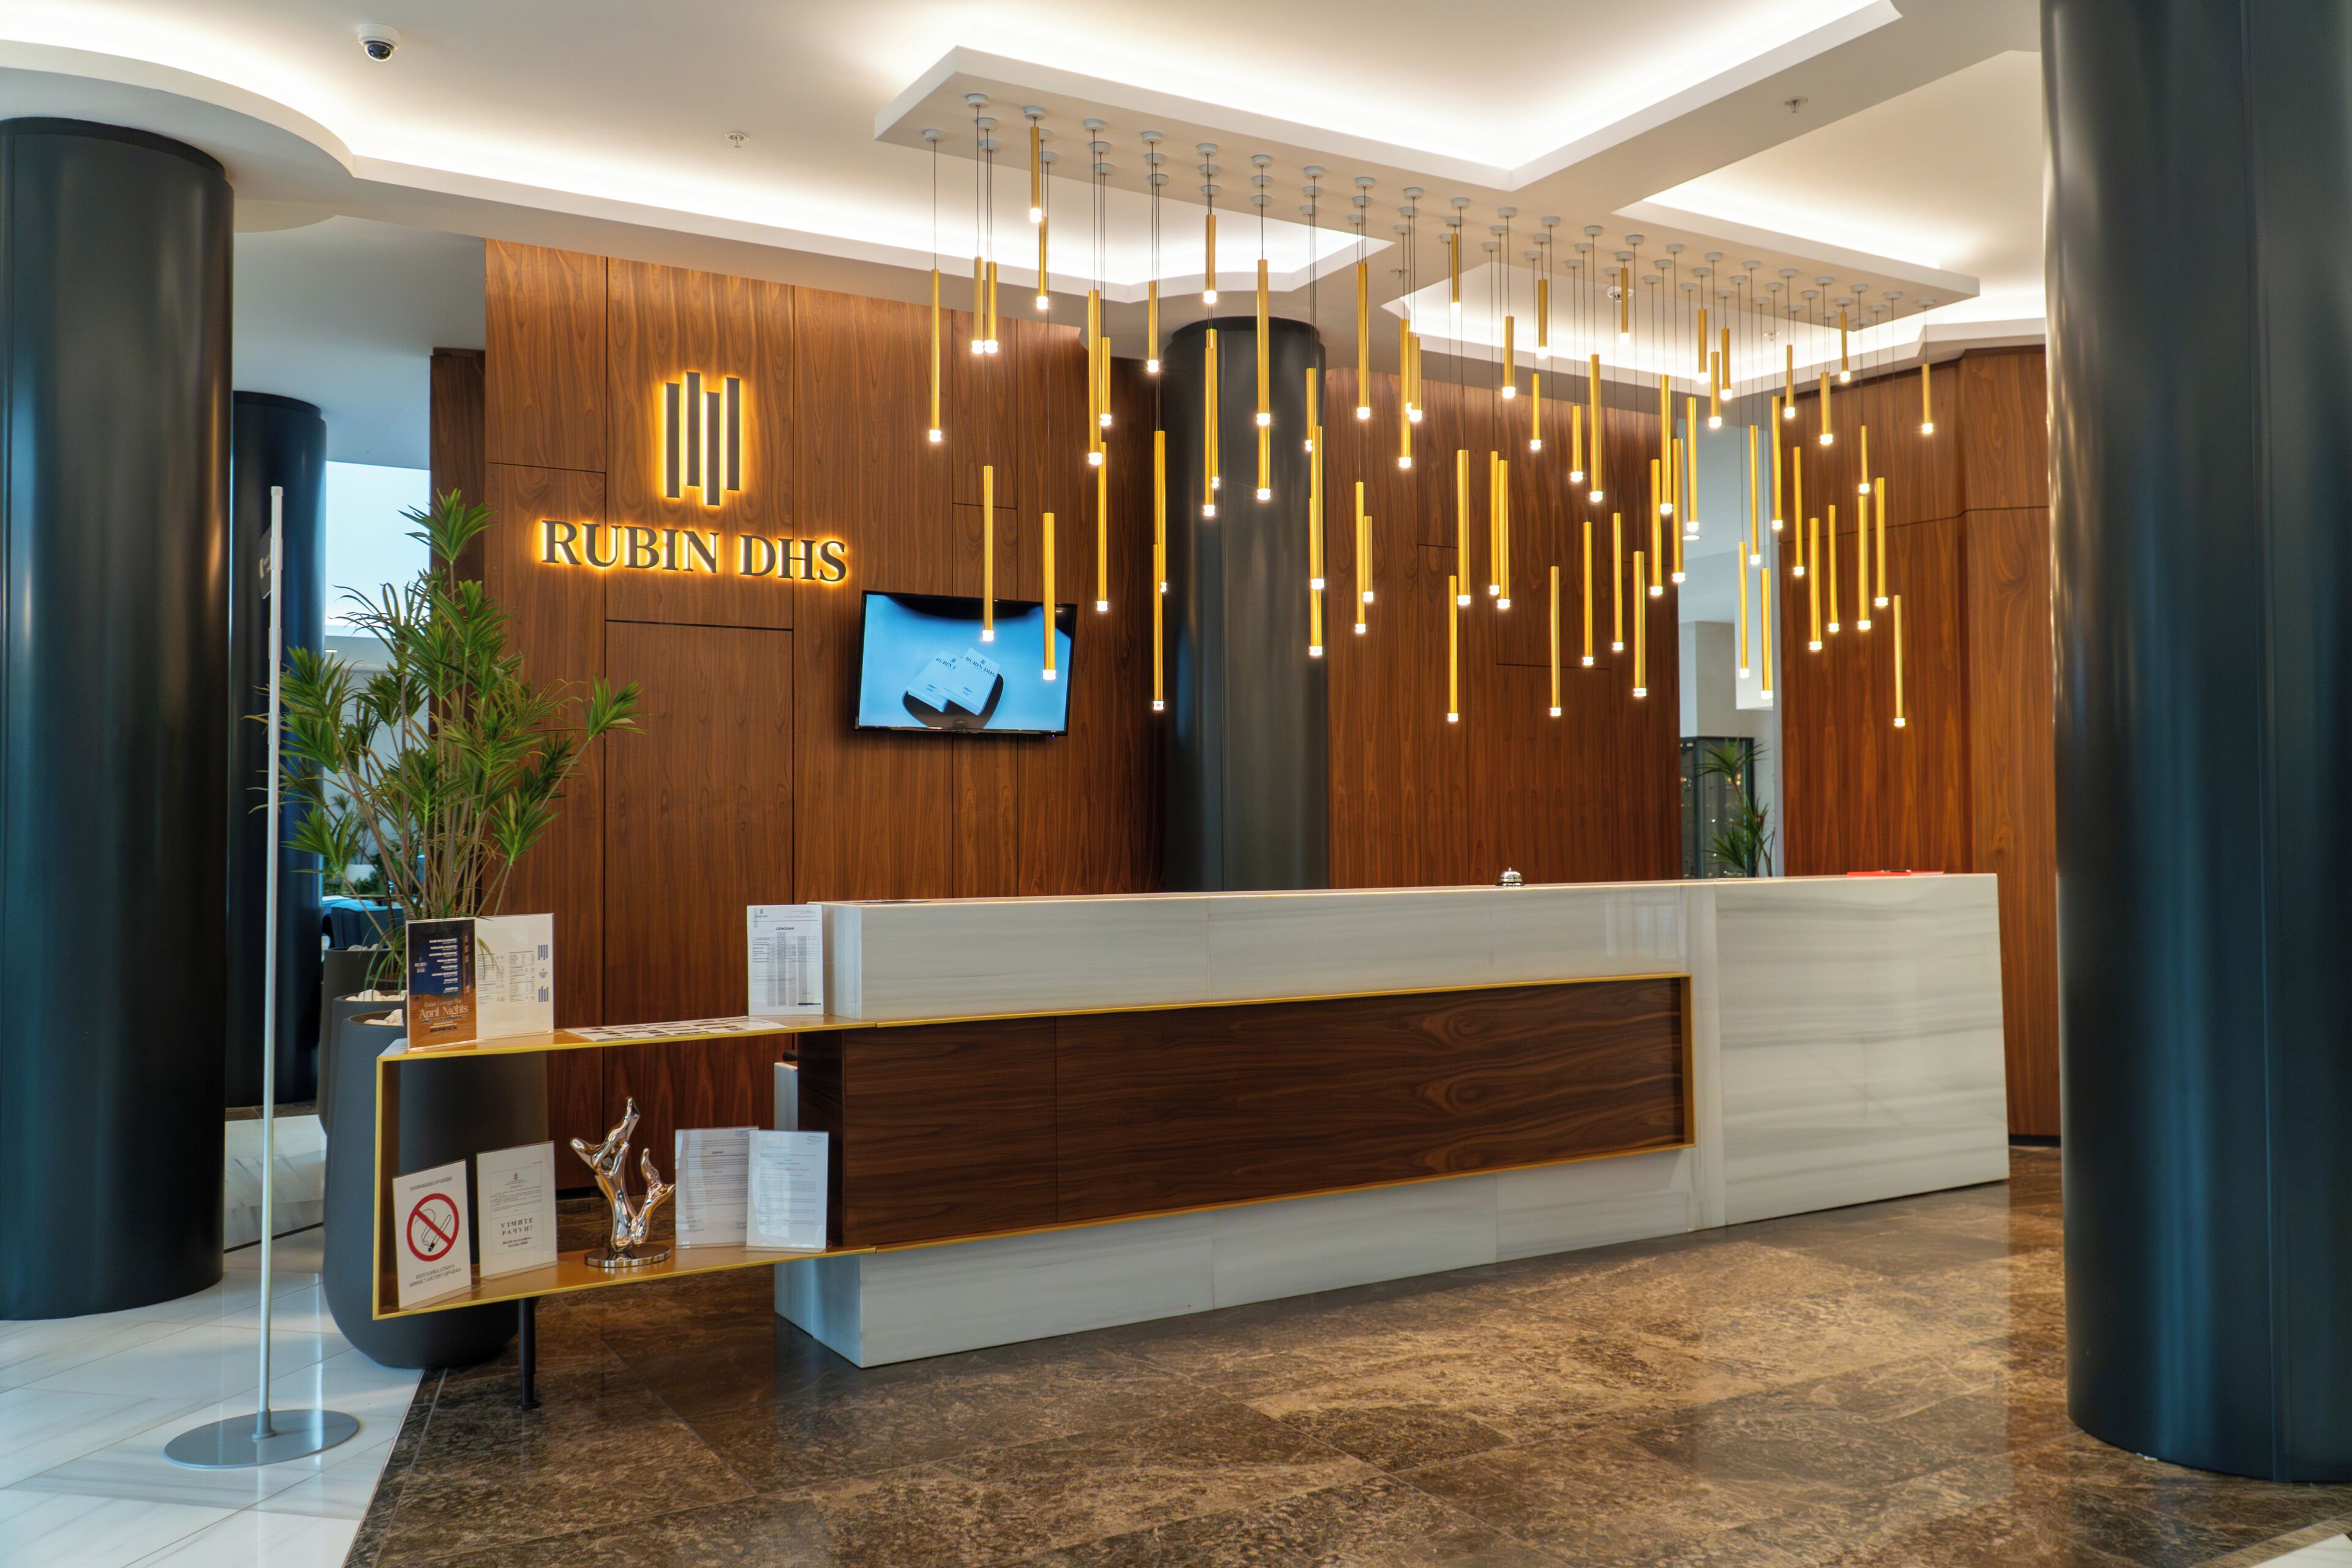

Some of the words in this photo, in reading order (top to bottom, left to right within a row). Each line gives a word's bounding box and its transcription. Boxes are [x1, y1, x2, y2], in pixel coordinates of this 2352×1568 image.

[541, 520, 720, 573] RUBIN
[740, 534, 846, 582] DHS
[965, 657, 982, 669] RUBIN
[418, 1006, 439, 1020] April
[442, 1004, 469, 1017] Nights
